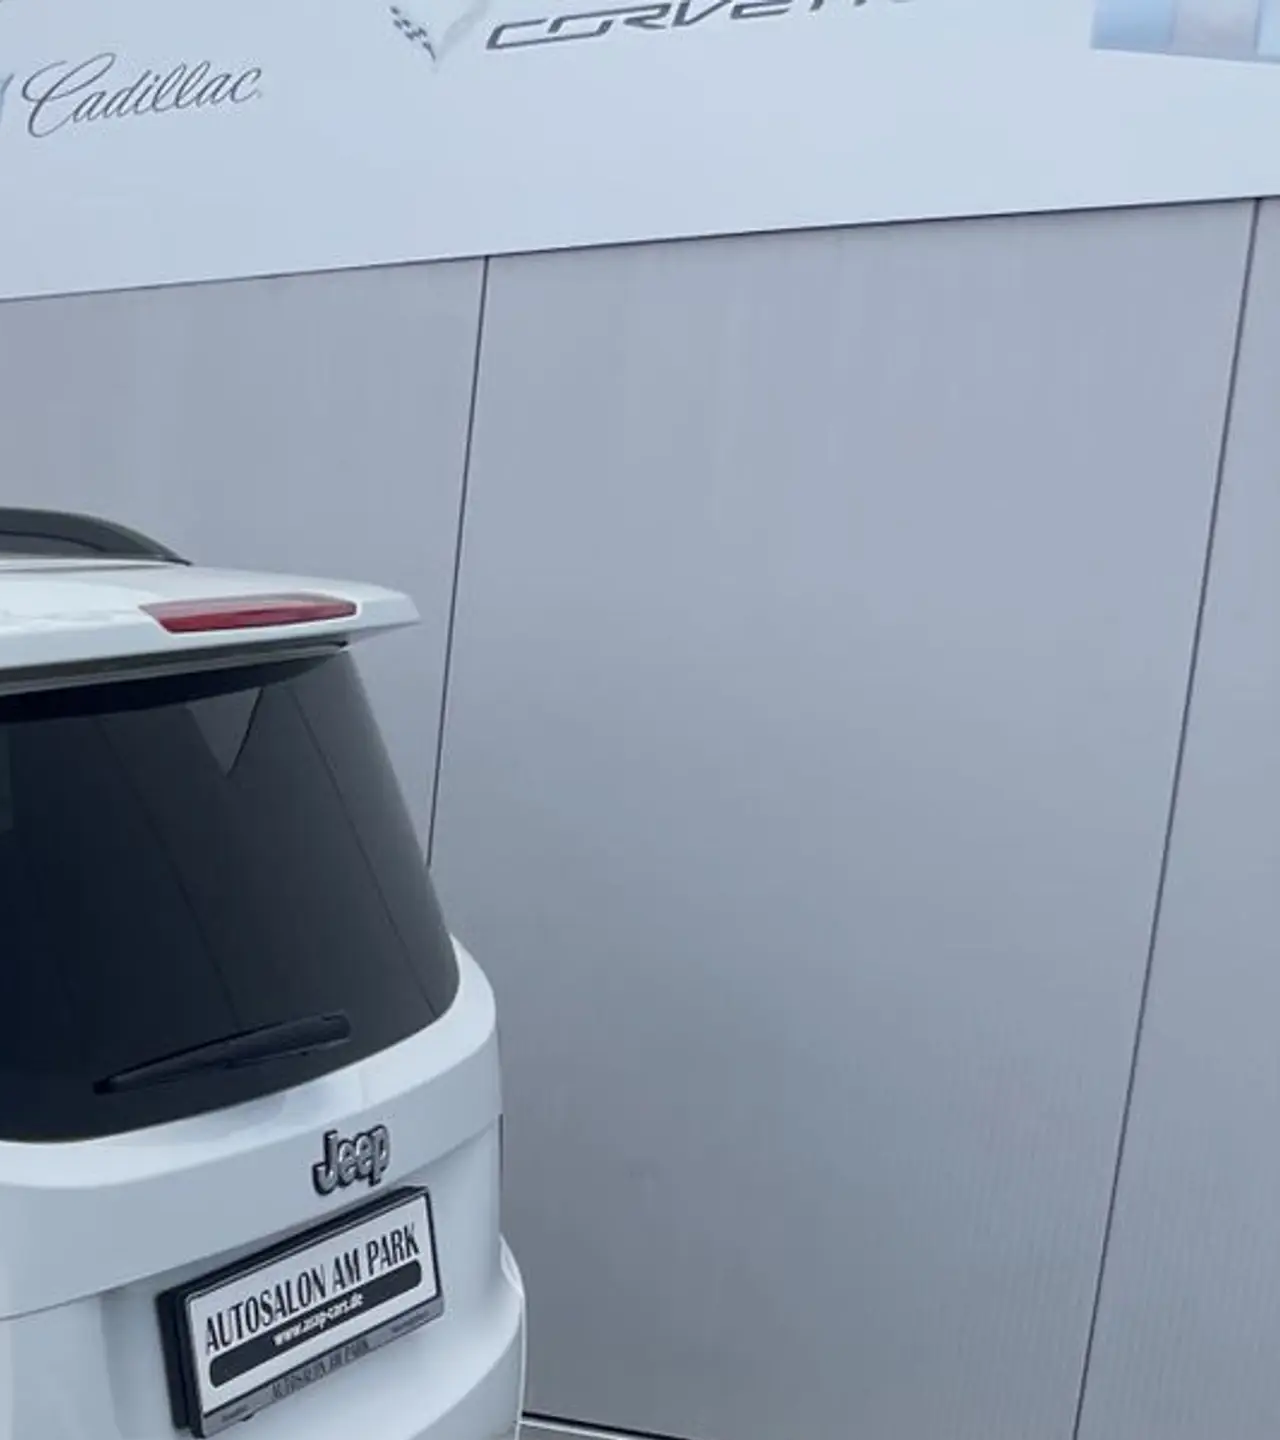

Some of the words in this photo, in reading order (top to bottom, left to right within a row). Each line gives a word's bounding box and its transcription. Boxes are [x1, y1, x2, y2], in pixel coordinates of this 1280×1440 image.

[486, 0, 908, 49] CORVE
[21, 52, 262, 138] Cadillac
[312, 1123, 390, 1196] Jeep
[206, 1263, 326, 1356] AUTOSALON
[332, 1247, 362, 1290] AM
[365, 1222, 420, 1276] PARK
